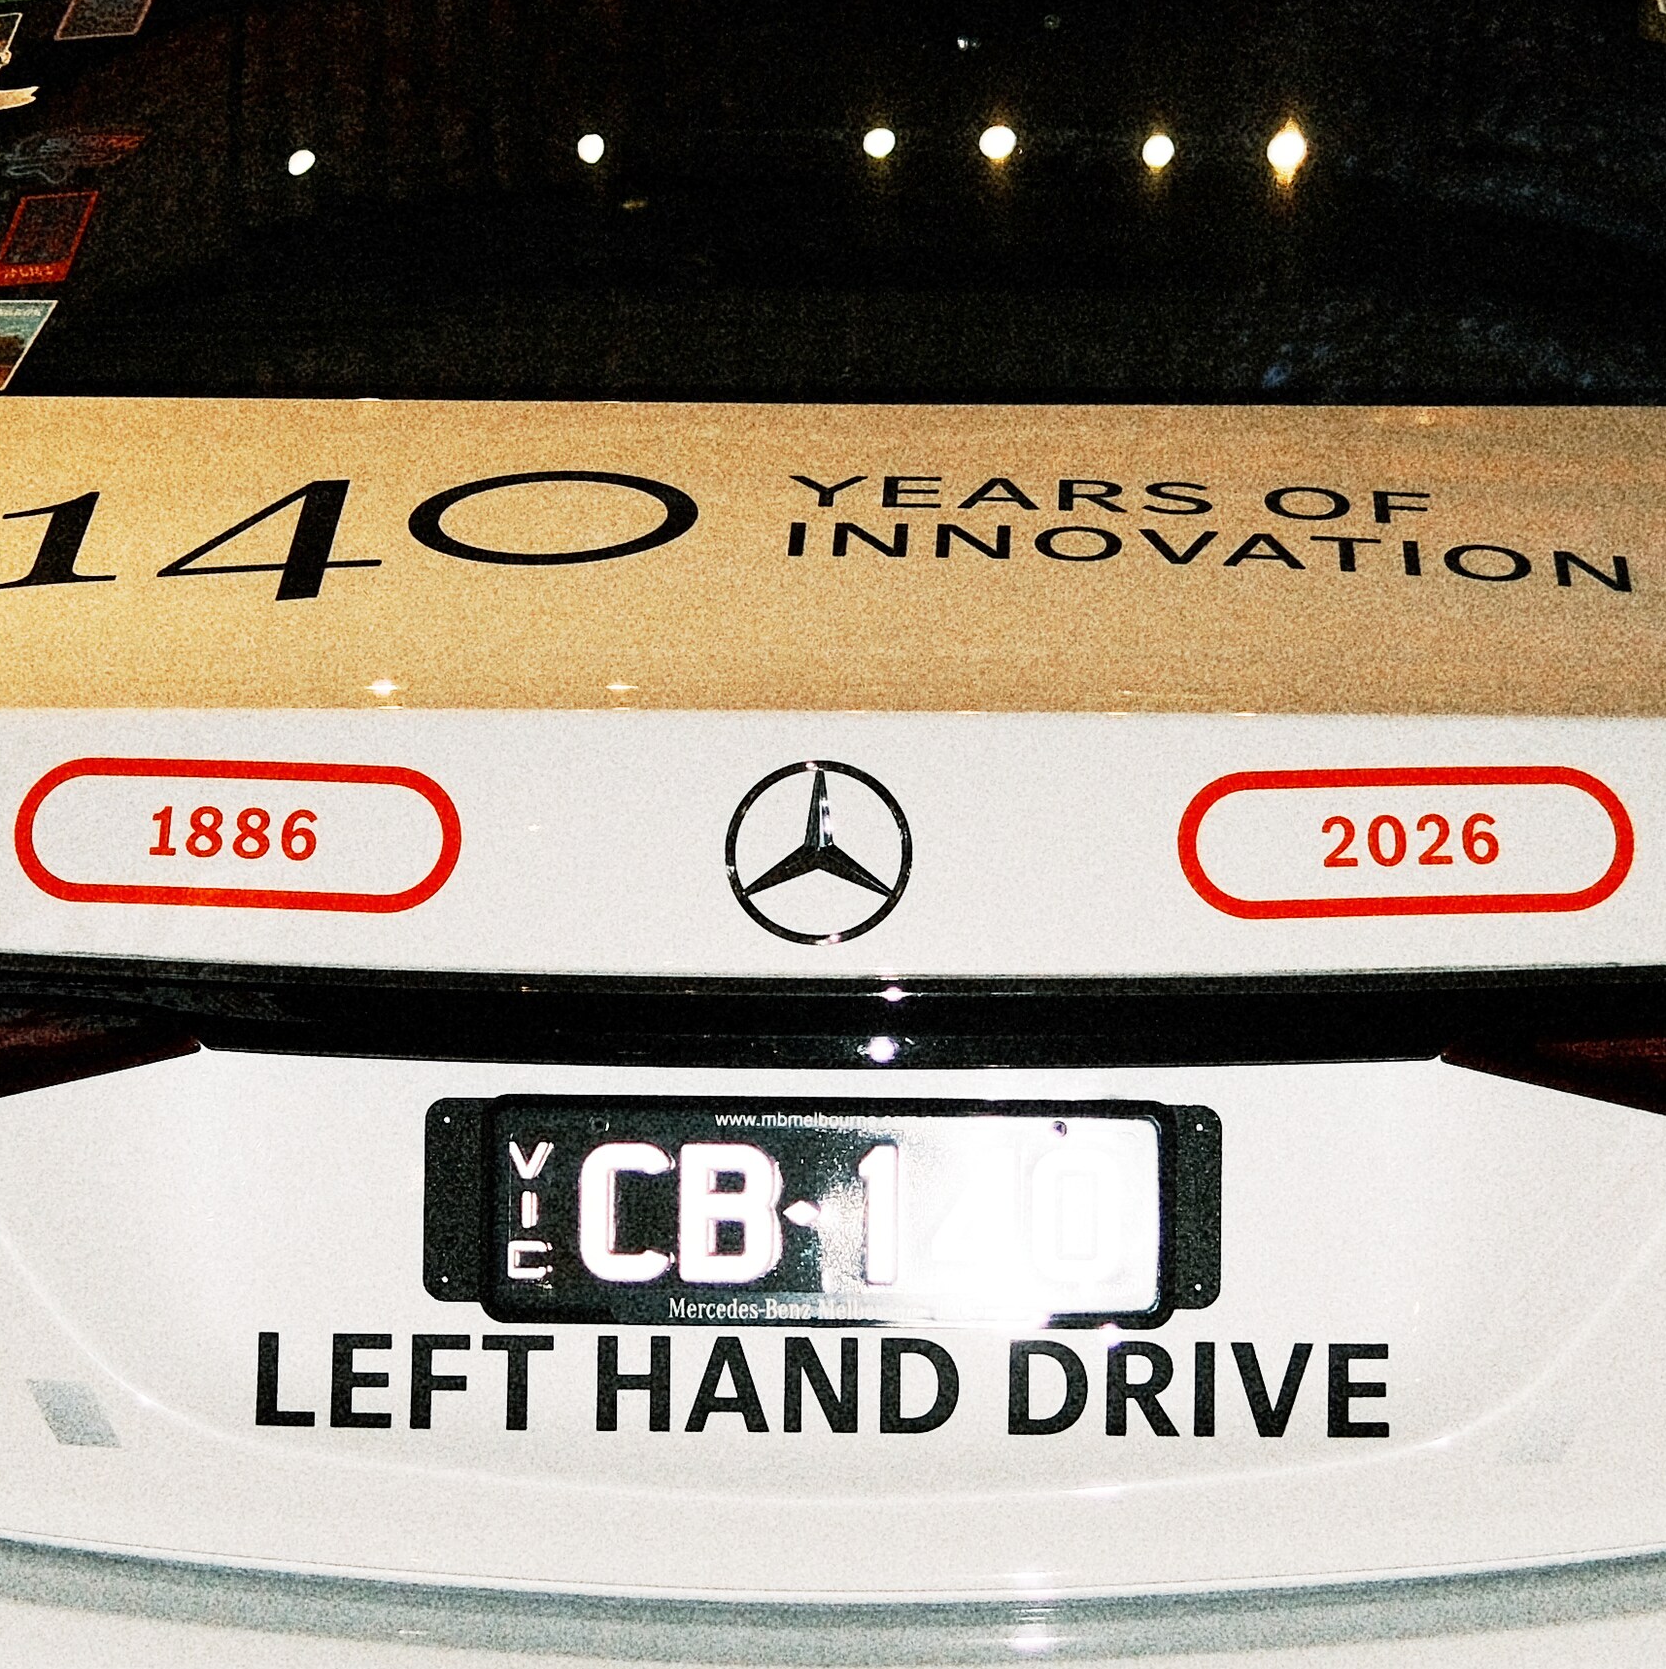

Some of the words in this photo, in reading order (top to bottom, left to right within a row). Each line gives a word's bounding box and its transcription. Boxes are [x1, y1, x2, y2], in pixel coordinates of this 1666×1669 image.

[791, 475, 1213, 516] YEARS
[1264, 486, 1429, 524] OF
[788, 522, 1632, 593] INNOVATION
[149, 805, 317, 862] 1886
[1322, 812, 1500, 868] 2026
[507, 1140, 554, 1280] VIC
[668, 1297, 810, 1320] Mercedes-Benz
[255, 1332, 554, 1431] LEFT
[596, 1335, 959, 1434] HAND
[1008, 1341, 1390, 1438] DRIVE
